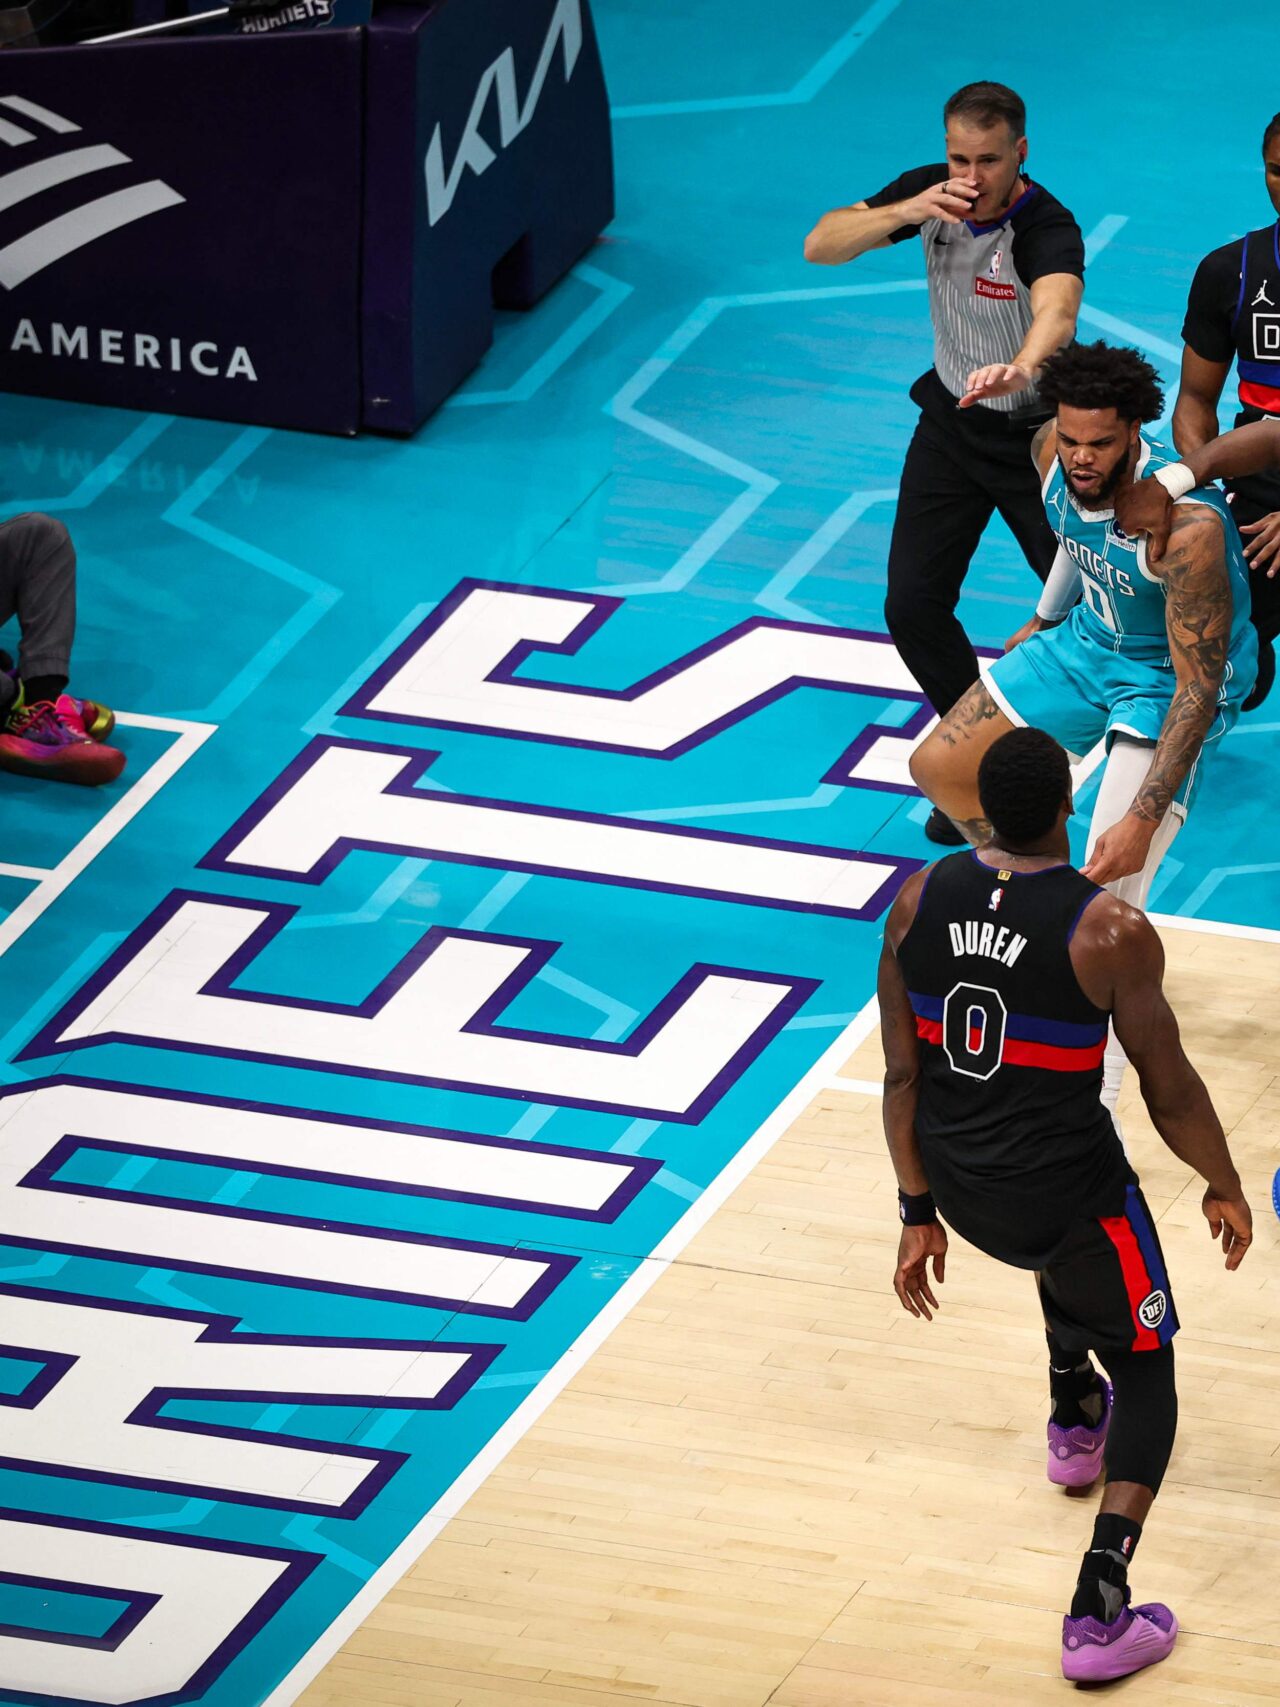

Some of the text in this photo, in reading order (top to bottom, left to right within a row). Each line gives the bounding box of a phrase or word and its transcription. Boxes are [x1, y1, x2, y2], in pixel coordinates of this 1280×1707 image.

[976, 280, 1015, 298] Emirates
[11, 319, 258, 382] AMERICA
[948, 920, 1028, 968] DUREN
[942, 981, 1008, 1081] 0
